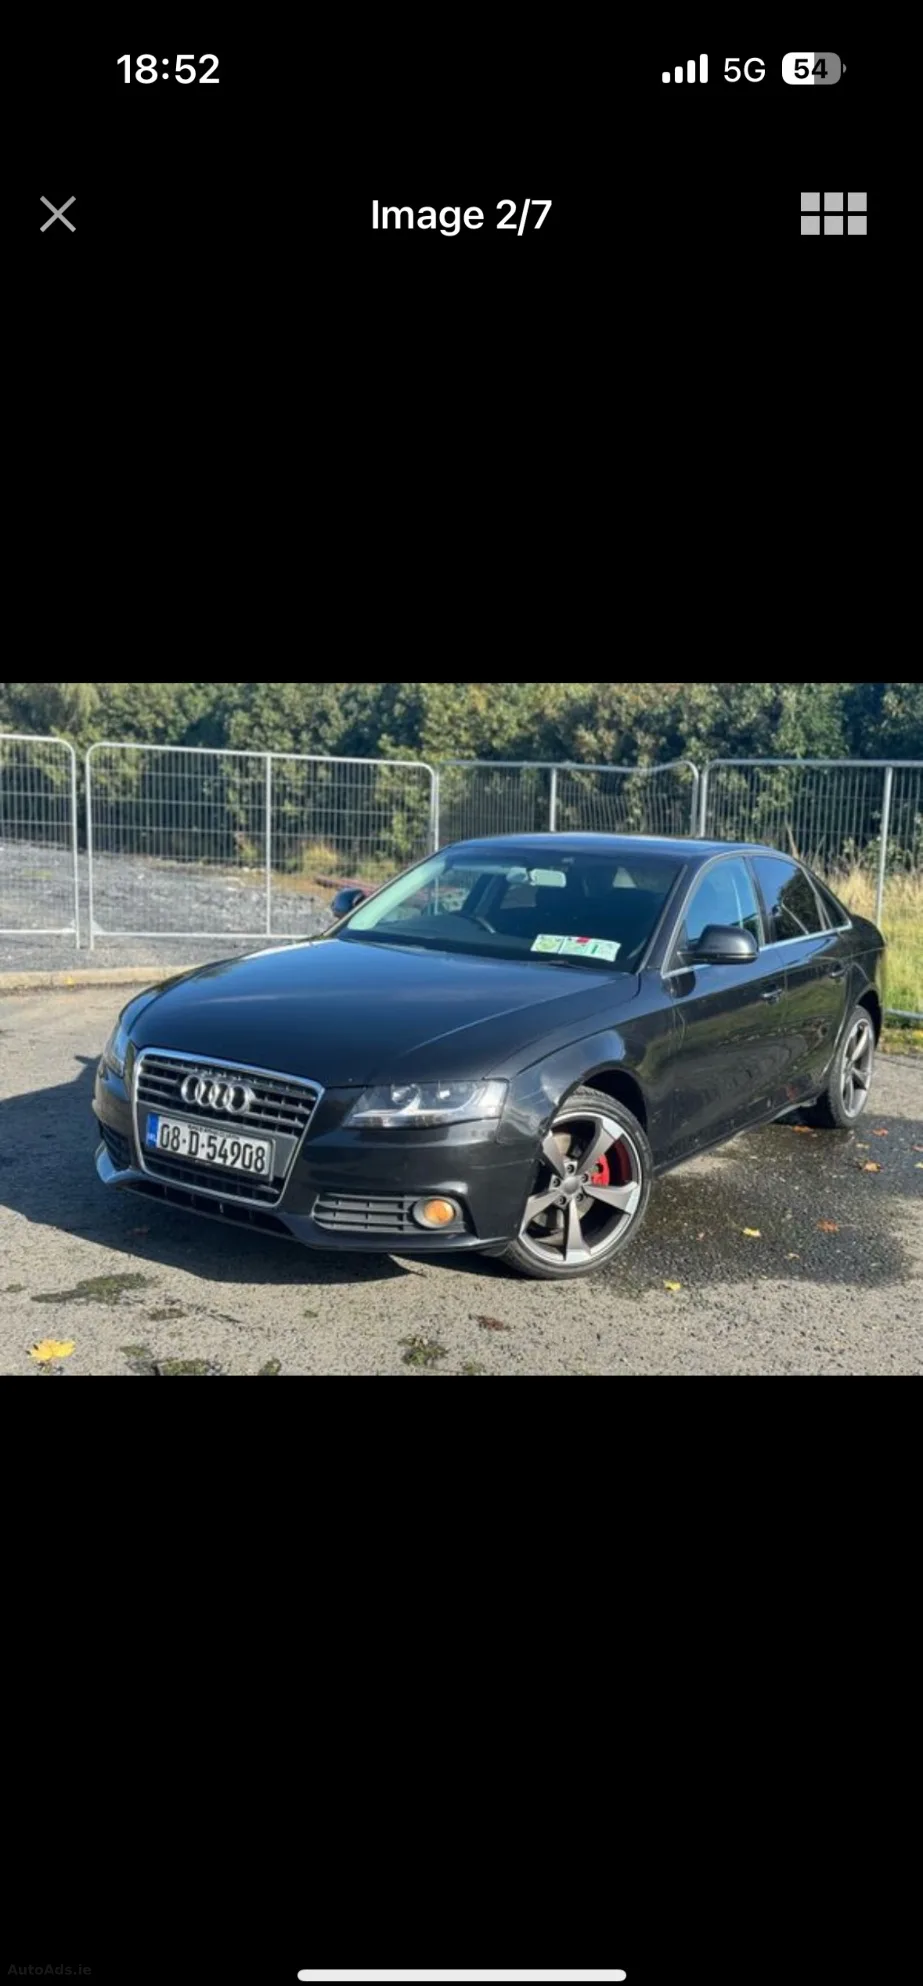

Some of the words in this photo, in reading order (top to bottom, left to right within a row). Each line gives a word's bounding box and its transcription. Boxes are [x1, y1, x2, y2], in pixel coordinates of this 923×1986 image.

[116, 53, 220, 85] 18:52
[723, 57, 766, 83] 5G
[794, 58, 829, 80] 54
[372, 200, 486, 236] Image
[496, 198, 553, 236] 2/7
